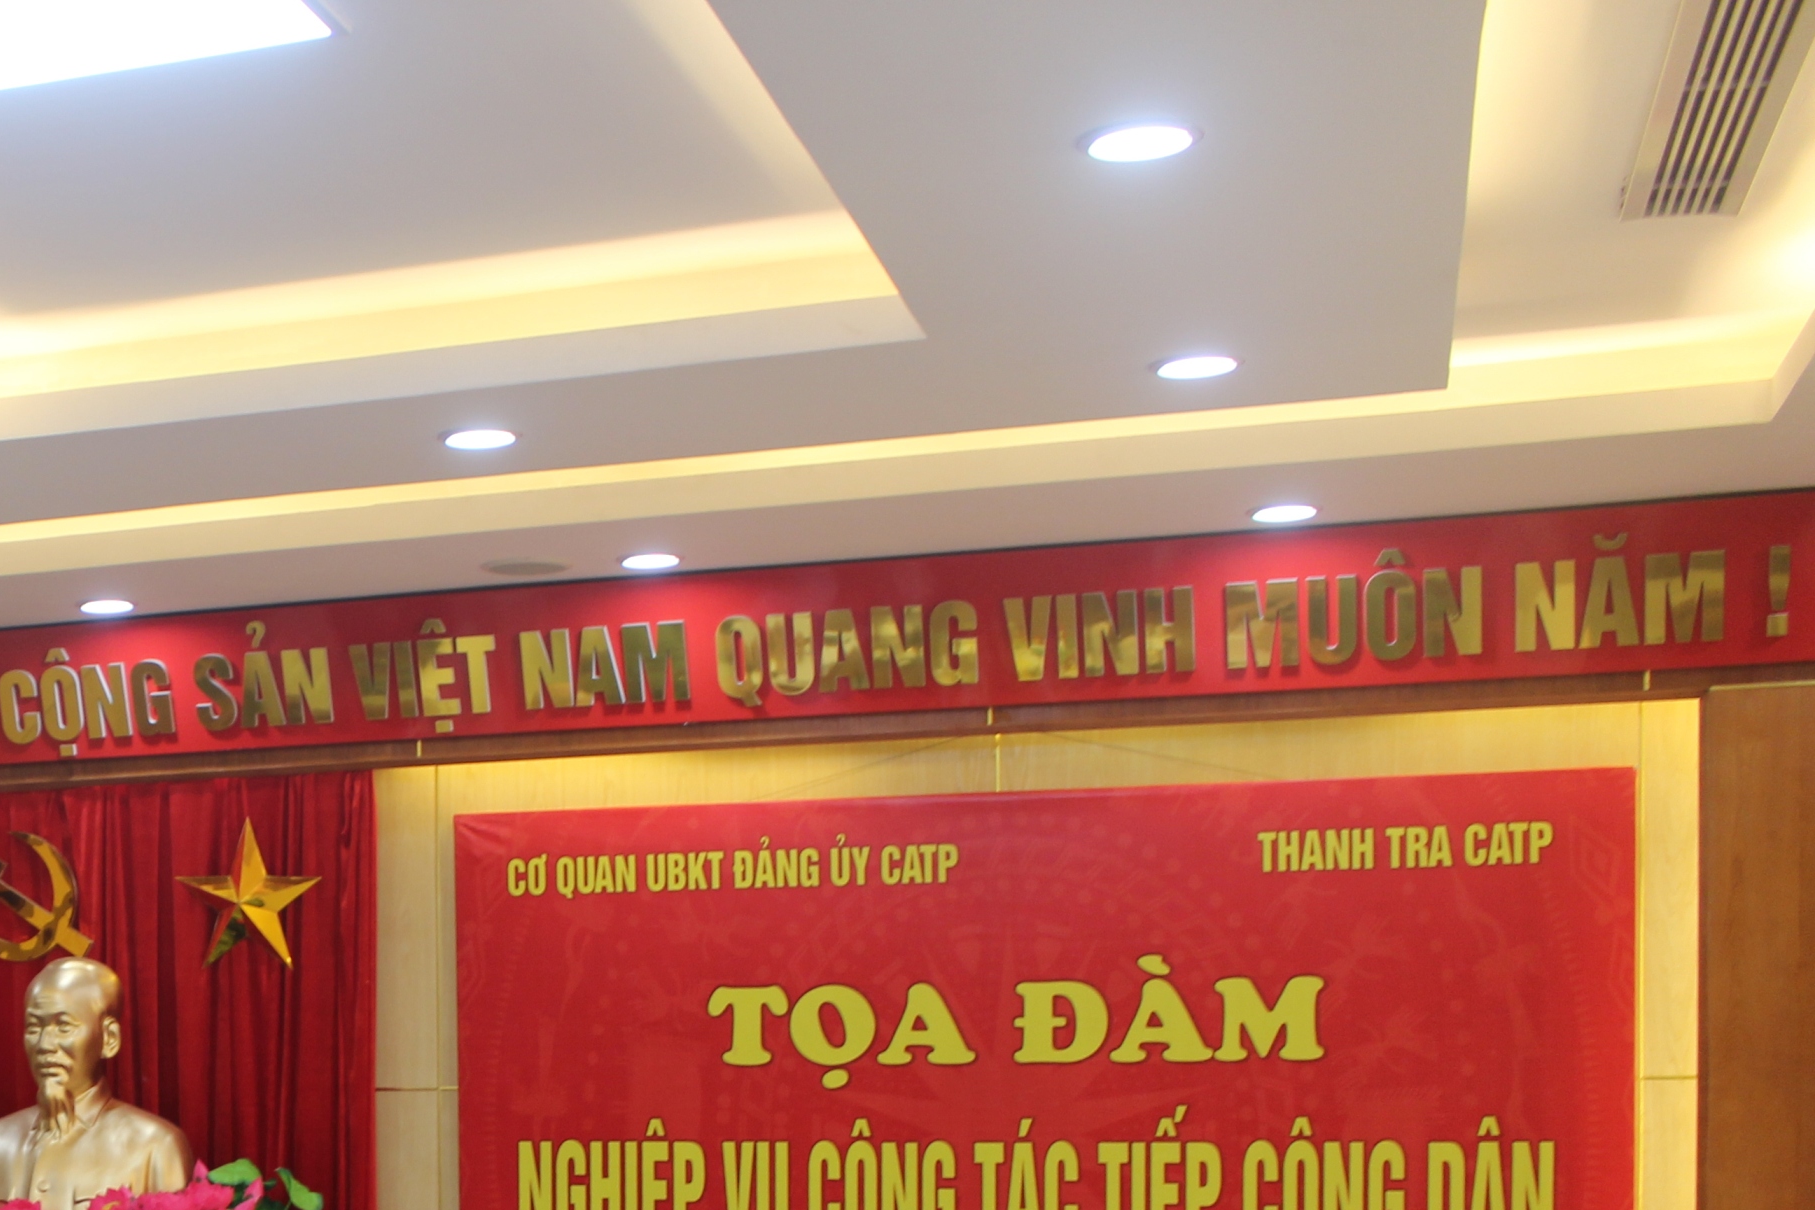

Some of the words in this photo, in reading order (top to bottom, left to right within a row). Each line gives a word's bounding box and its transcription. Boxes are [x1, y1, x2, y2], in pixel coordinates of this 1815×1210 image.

[194, 620, 334, 731] SẢN
[348, 618, 495, 733] VIỆT
[519, 619, 691, 710] NAM
[715, 600, 979, 706] QUANG
[1002, 585, 1196, 681] VINH
[1224, 548, 1483, 669] MUÔN
[1514, 532, 1726, 653] NĂM
[507, 853, 547, 896] CƠ
[556, 854, 636, 898] QUAN
[646, 850, 724, 892] UBKT
[733, 836, 820, 889] ĐẢNG
[830, 834, 871, 886] ỦY
[881, 842, 959, 885] CATP
[1257, 828, 1375, 872] THANH
[1385, 825, 1453, 869] TRA
[1464, 821, 1554, 866] CATP
[707, 982, 977, 1090] TỌA
[1013, 953, 1325, 1064] ĐÀM
